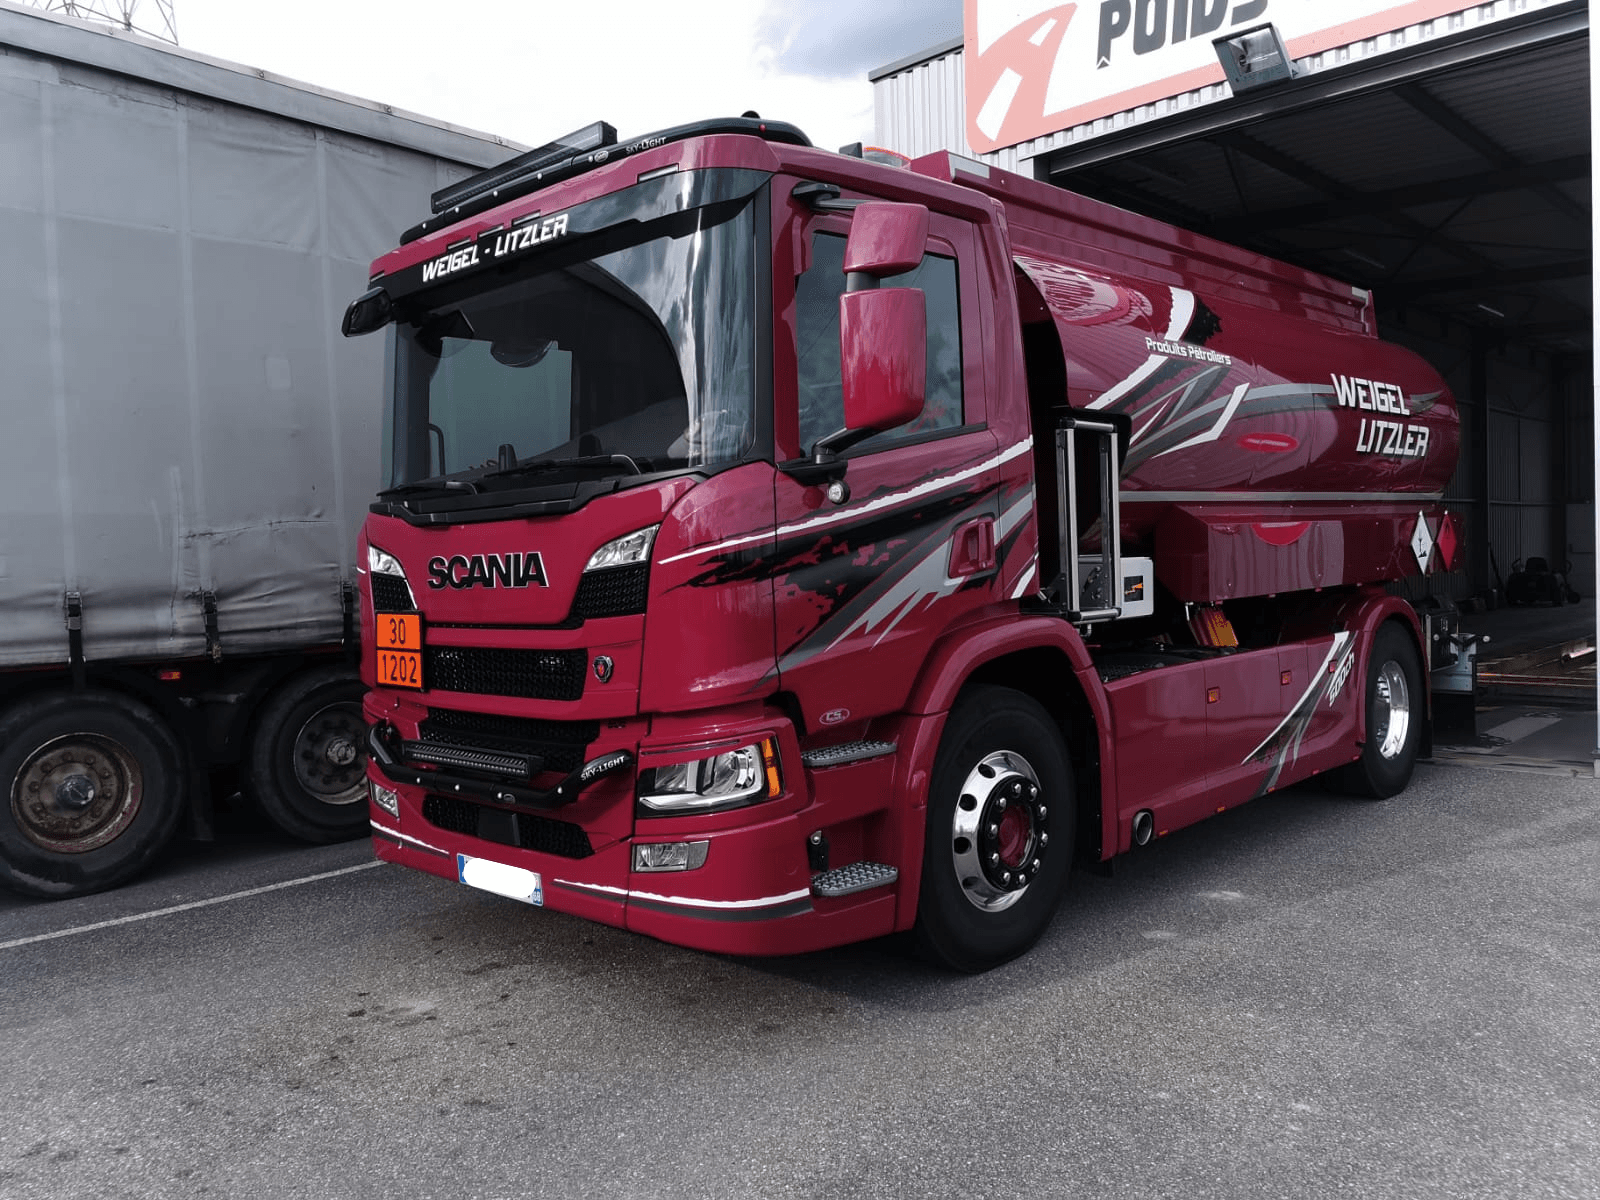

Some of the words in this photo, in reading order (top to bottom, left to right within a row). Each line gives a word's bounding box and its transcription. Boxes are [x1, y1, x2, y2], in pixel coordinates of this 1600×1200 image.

[626, 136, 667, 154] SKY-LIGHT
[422, 244, 480, 282] WEIGEL
[494, 213, 569, 257] LITZLER
[1145, 336, 1188, 357] Produits
[1330, 372, 1410, 416] WEIGEL
[1355, 418, 1430, 457] LITZLER
[427, 551, 549, 590] SCANIA
[388, 617, 407, 646] 30
[382, 653, 418, 684] 1202
[580, 755, 625, 781] SKY-LIGHT
